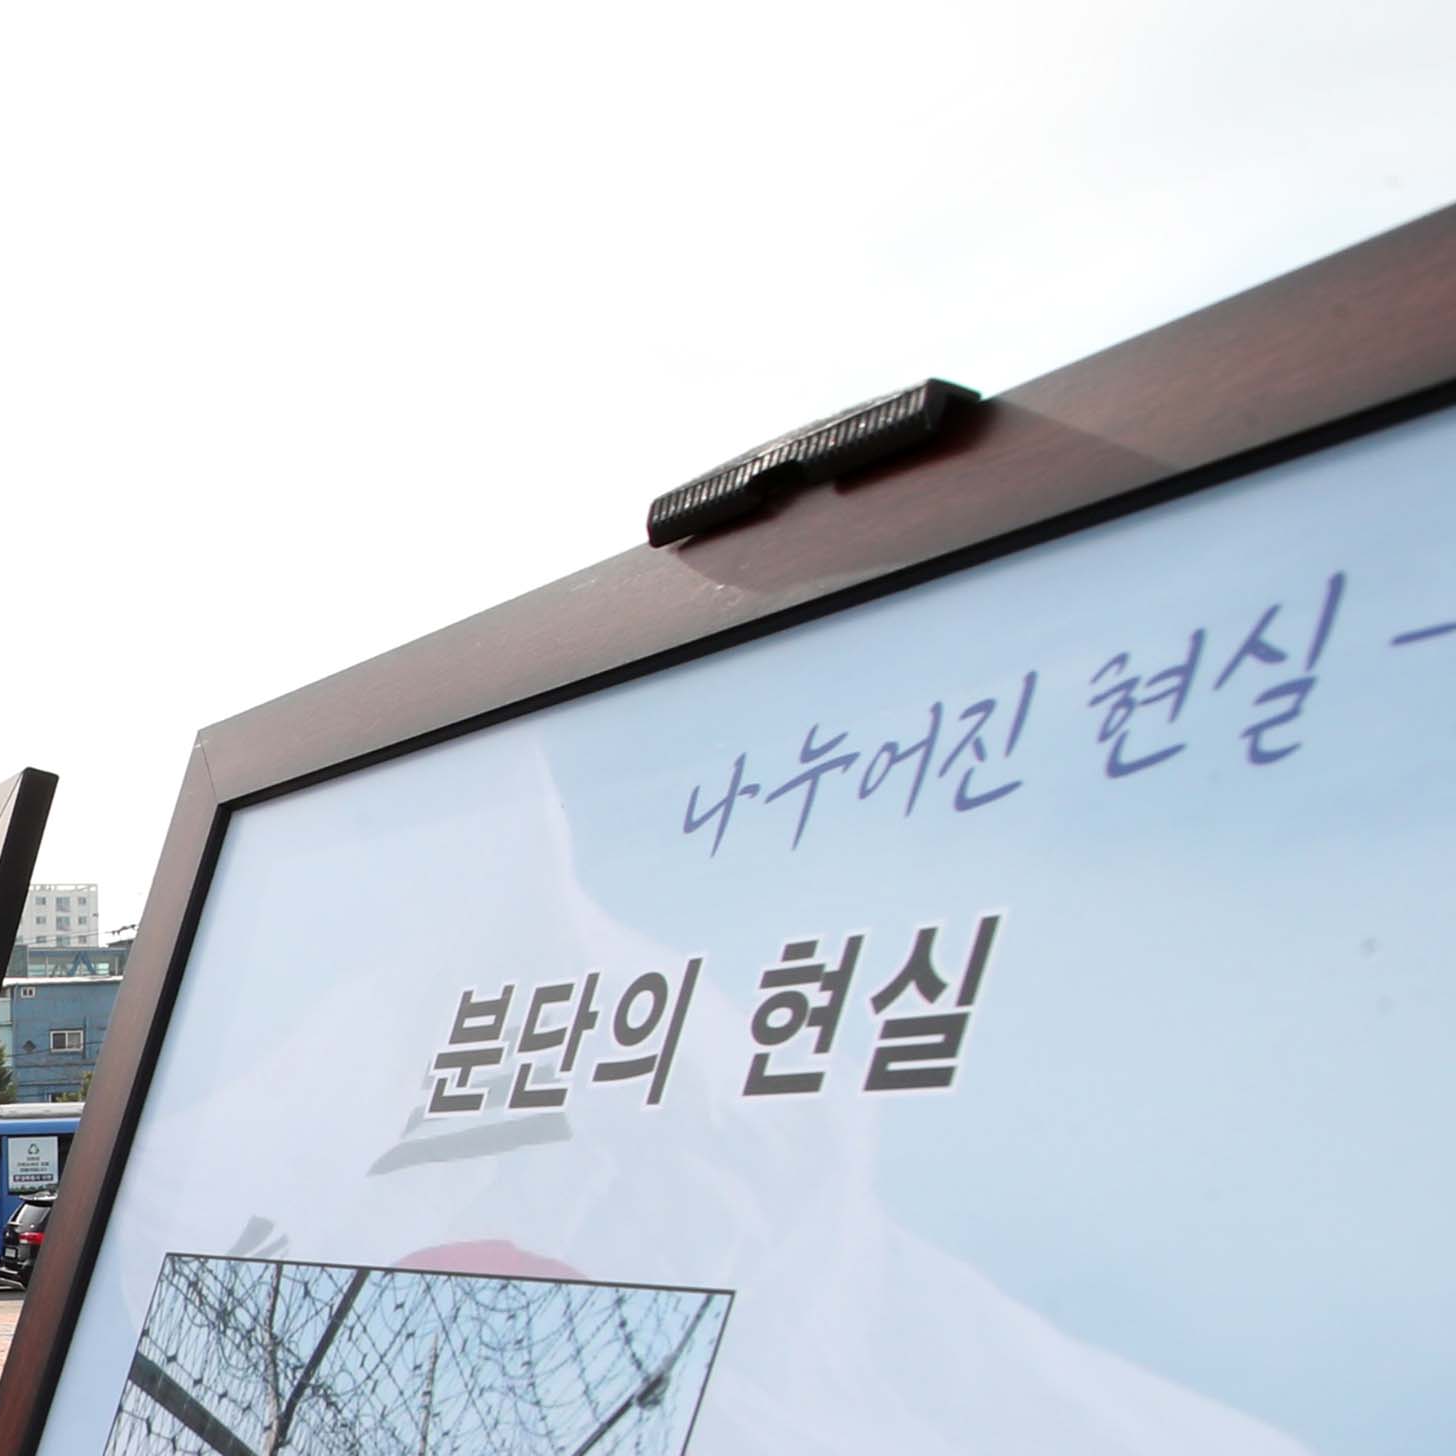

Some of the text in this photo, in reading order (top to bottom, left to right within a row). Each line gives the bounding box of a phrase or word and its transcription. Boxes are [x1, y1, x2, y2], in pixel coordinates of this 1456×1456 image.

[681, 671, 1039, 859] 나누어진
[1089, 570, 1347, 779] 현실
[426, 913, 1002, 1118] 분단의 현실
